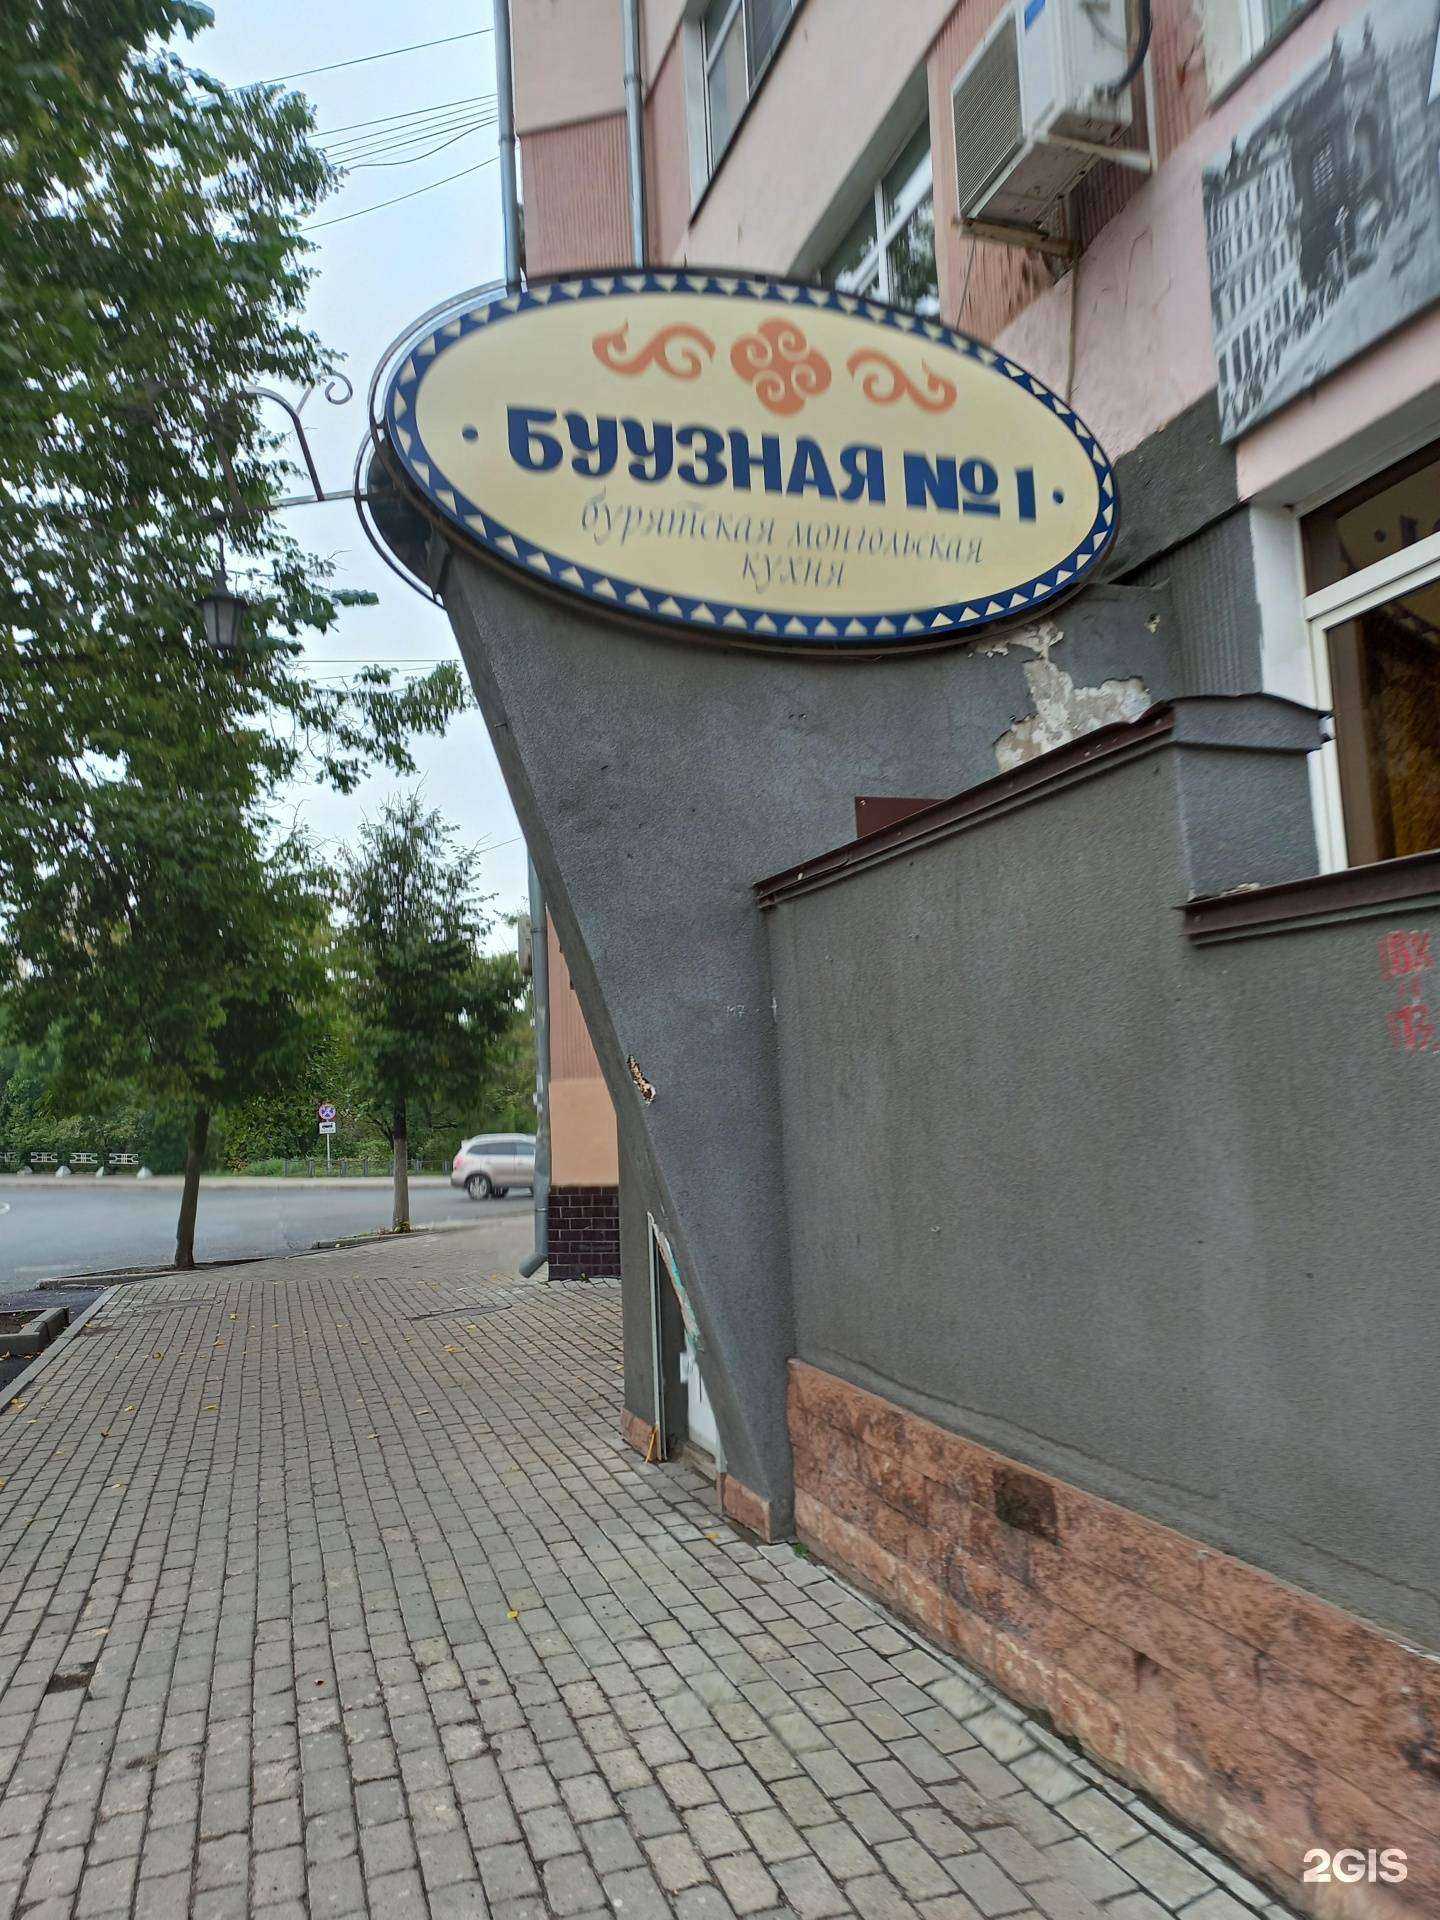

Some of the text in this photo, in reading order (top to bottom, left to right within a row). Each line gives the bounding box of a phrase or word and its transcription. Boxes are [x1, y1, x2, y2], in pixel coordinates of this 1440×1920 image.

[506, 404, 886, 505] БУУЗНАЯ
[580, 485, 985, 565] бурятская монгольская
[742, 551, 845, 594] кухня
